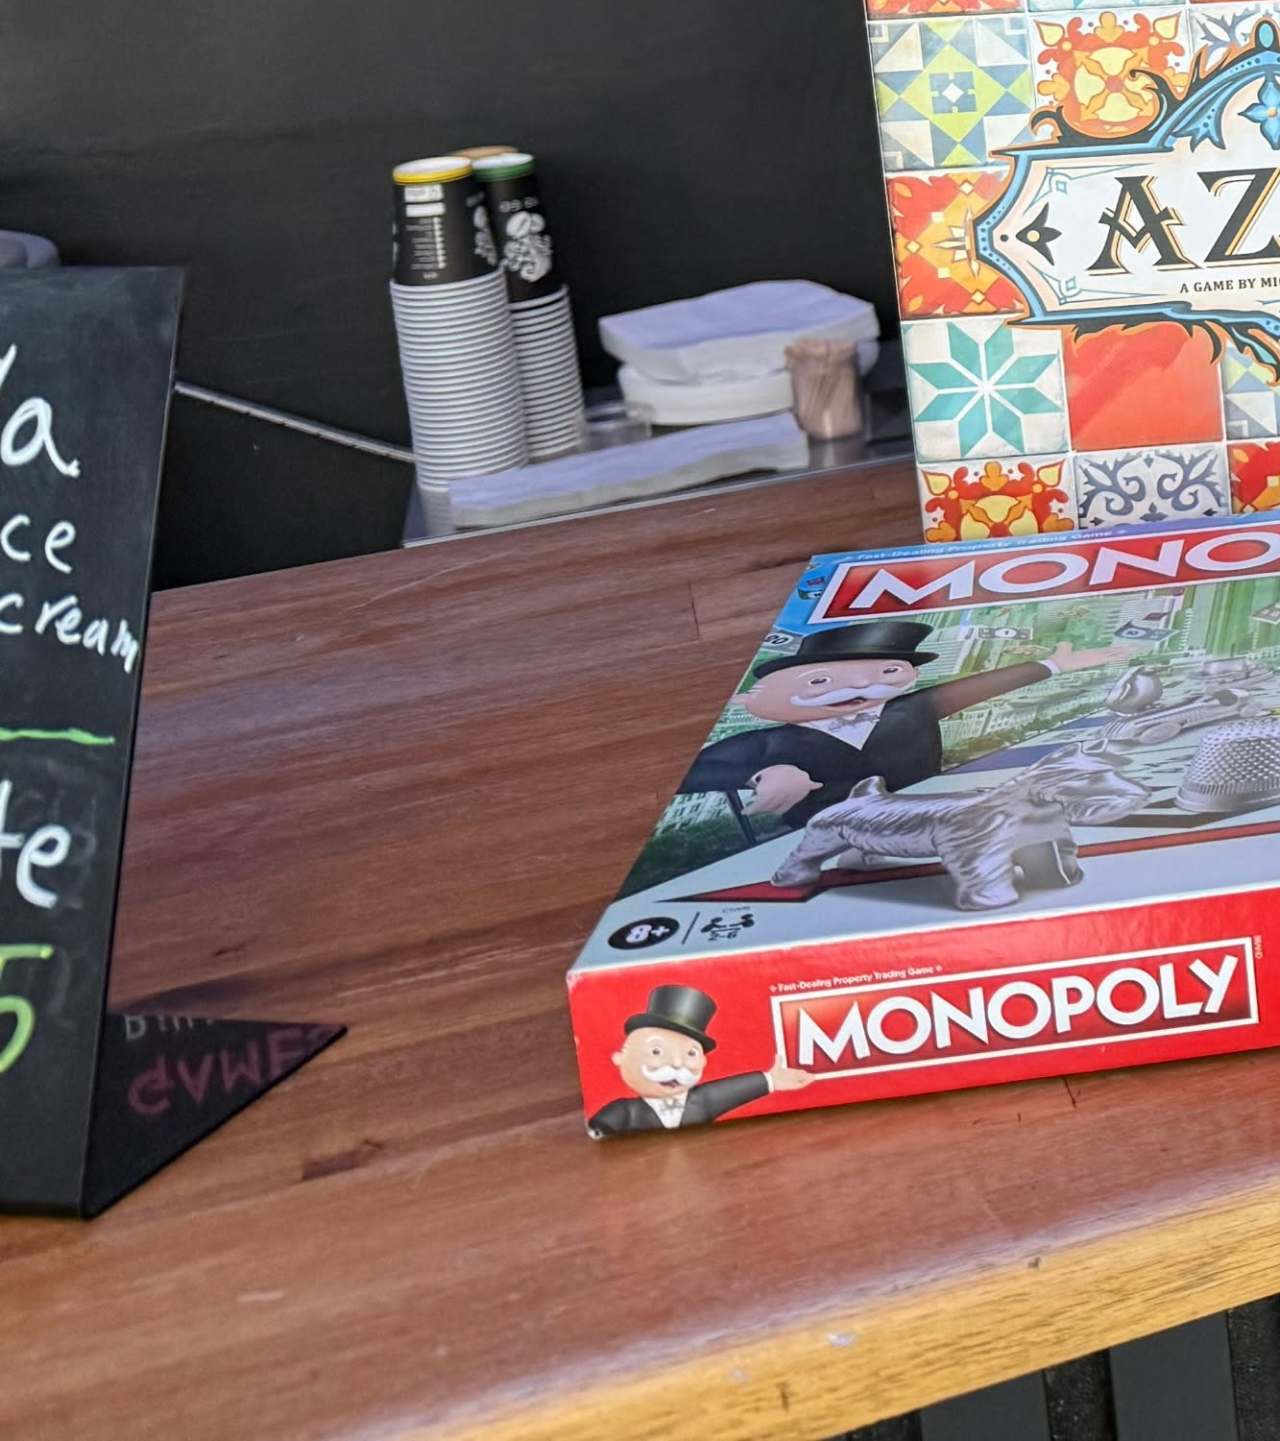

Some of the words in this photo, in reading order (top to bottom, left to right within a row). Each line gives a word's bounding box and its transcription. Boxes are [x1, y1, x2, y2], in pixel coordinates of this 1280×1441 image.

[1179, 282, 1189, 294] A
[1193, 279, 1235, 294] GAME
[1238, 277, 1257, 290] BY
[624, 923, 671, 945] 8+
[833, 974, 872, 986] Property
[908, 966, 934, 976] Game
[798, 954, 1239, 1067] MONOPOLY
